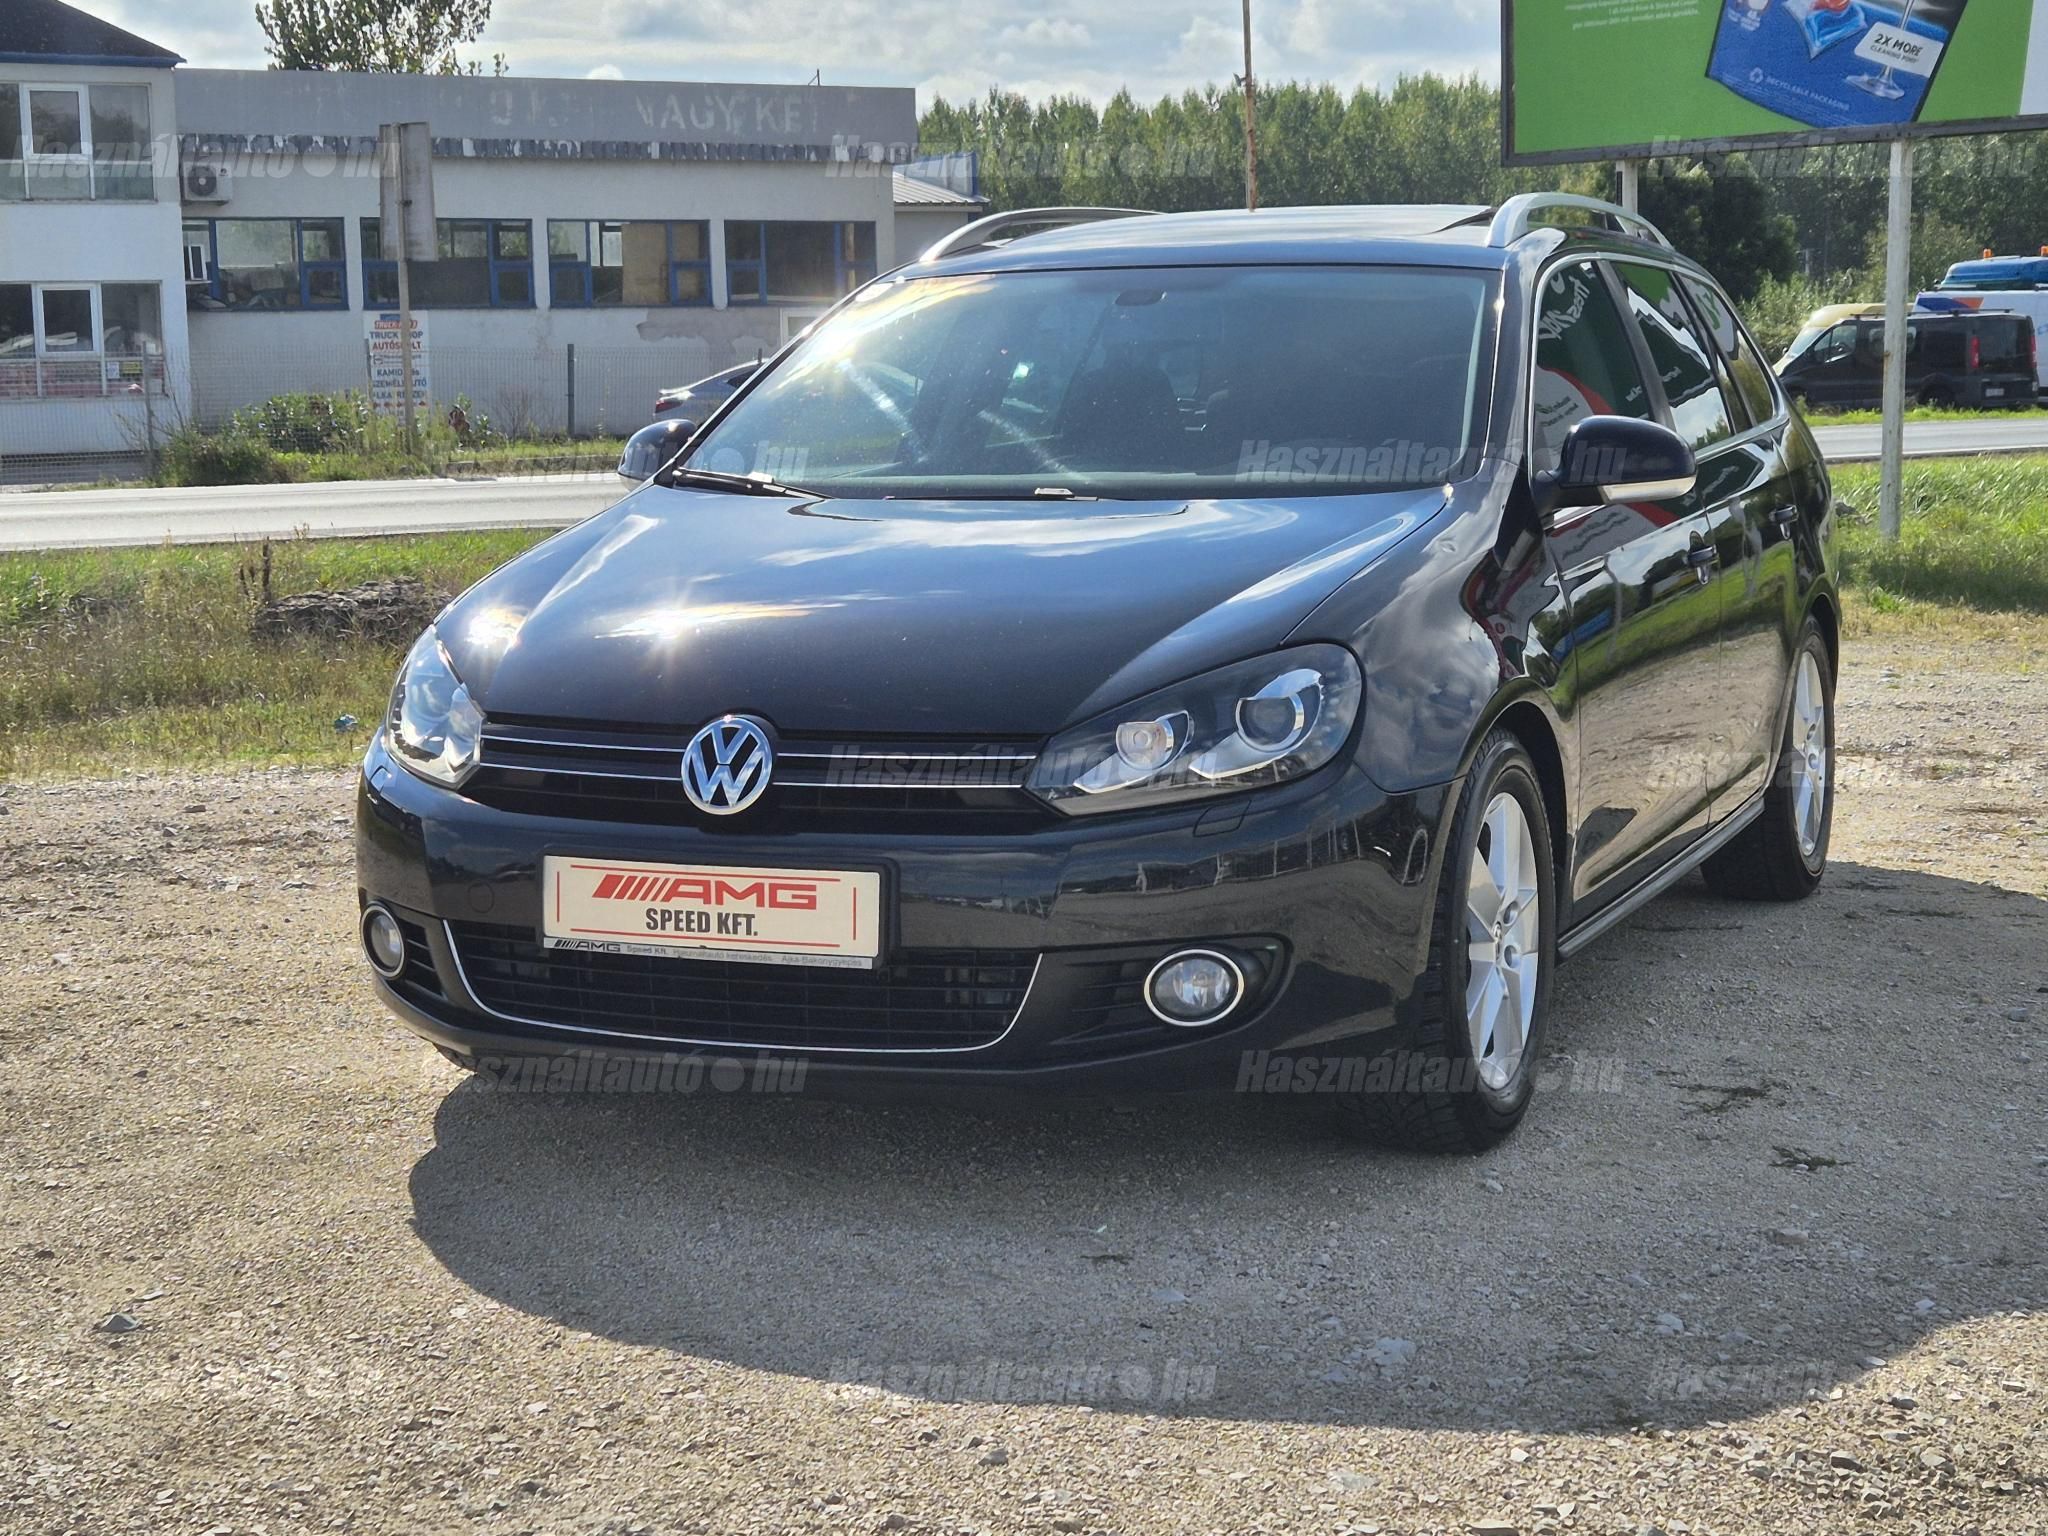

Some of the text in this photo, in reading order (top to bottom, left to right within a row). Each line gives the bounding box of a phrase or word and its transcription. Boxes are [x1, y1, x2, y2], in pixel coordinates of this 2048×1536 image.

[1874, 33, 1923, 57] 2X MORE
[369, 331, 399, 339] TRUCK
[372, 340, 422, 350] AUTÓSLT
[645, 907, 759, 937] SPEED KFT.
[575, 941, 621, 953] AMG
